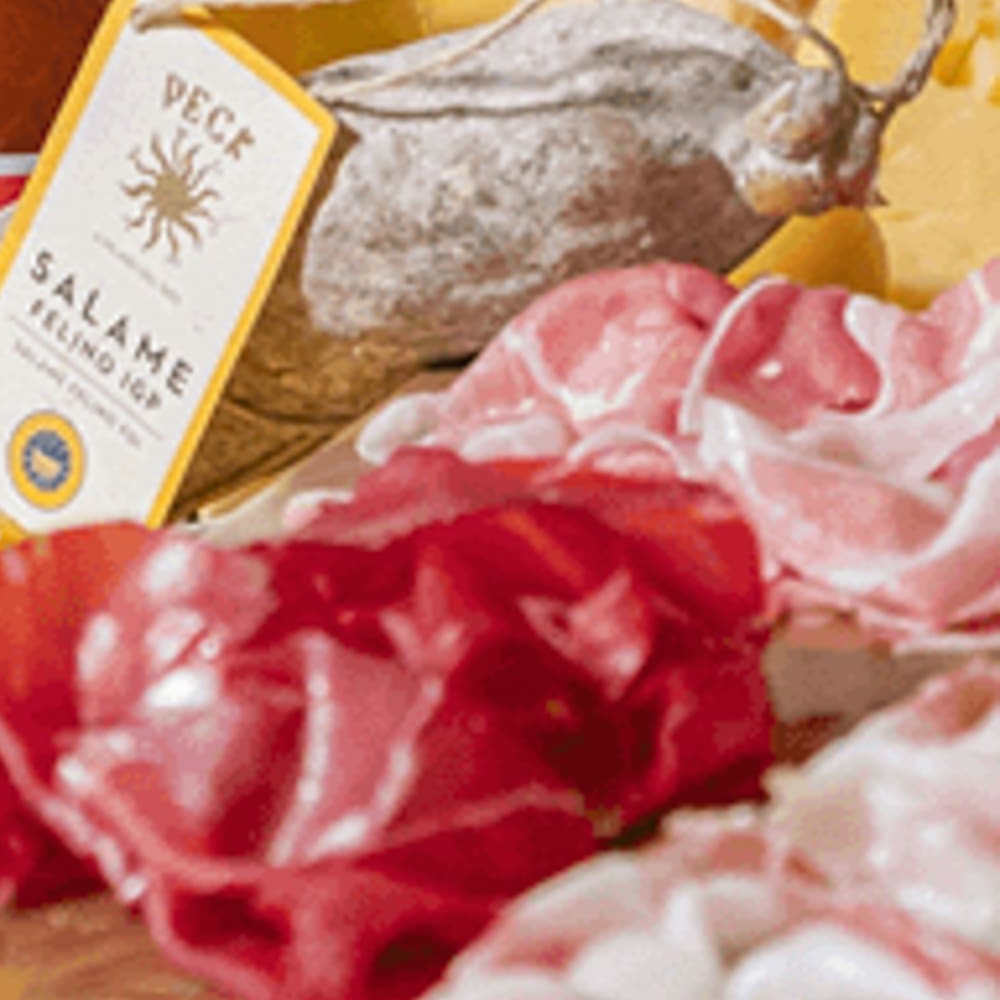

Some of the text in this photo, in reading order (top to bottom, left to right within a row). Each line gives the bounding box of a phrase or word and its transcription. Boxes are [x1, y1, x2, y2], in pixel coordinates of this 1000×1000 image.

[163, 71, 256, 161] PECK
[29, 298, 163, 410] FELINO IGP
[30, 249, 193, 396] SALAME
